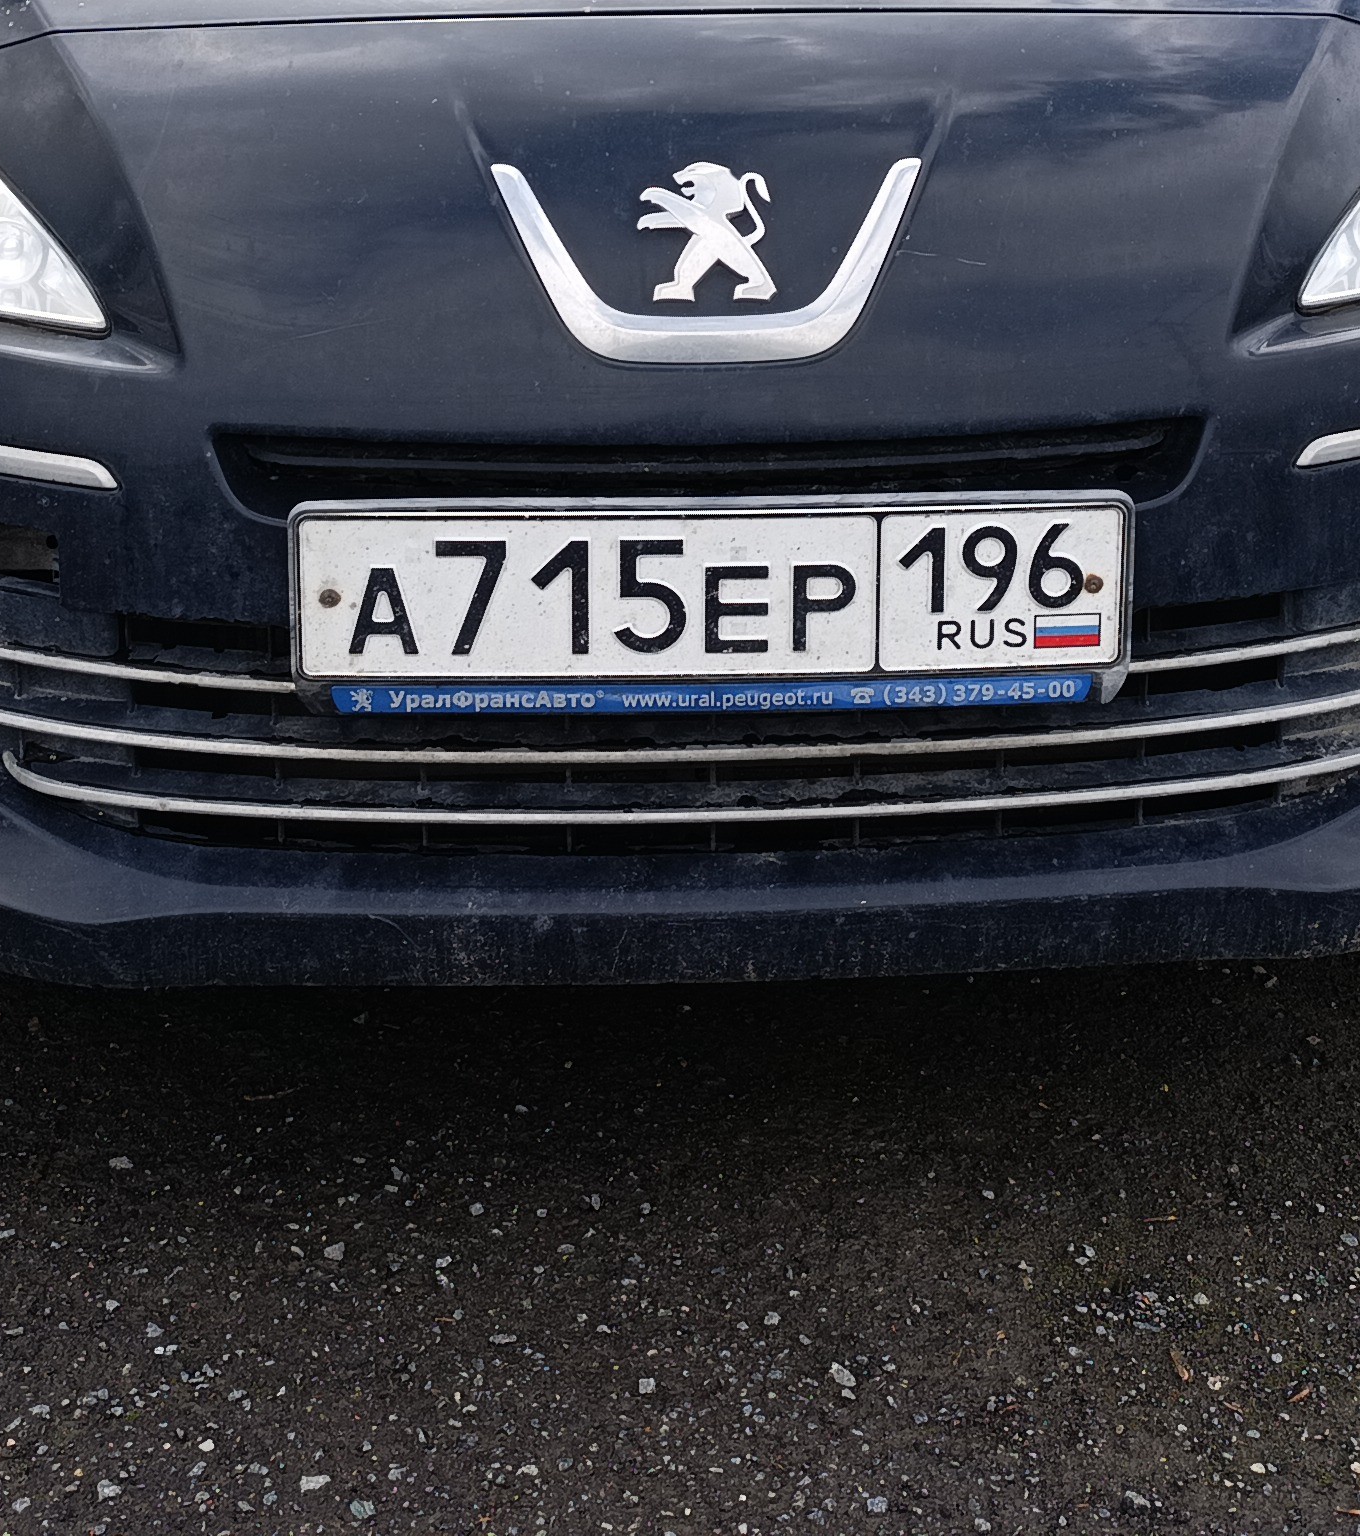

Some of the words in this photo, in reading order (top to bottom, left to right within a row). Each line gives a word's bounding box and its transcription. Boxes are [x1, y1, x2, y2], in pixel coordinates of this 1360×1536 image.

[348, 538, 857, 656] А715ЕР
[898, 522, 1085, 614] 196
[936, 617, 1028, 651] RUS
[621, 687, 834, 711] www.ural.peugeot.ru
[882, 683, 947, 706] (343)
[953, 680, 1076, 702] 379-45-00
